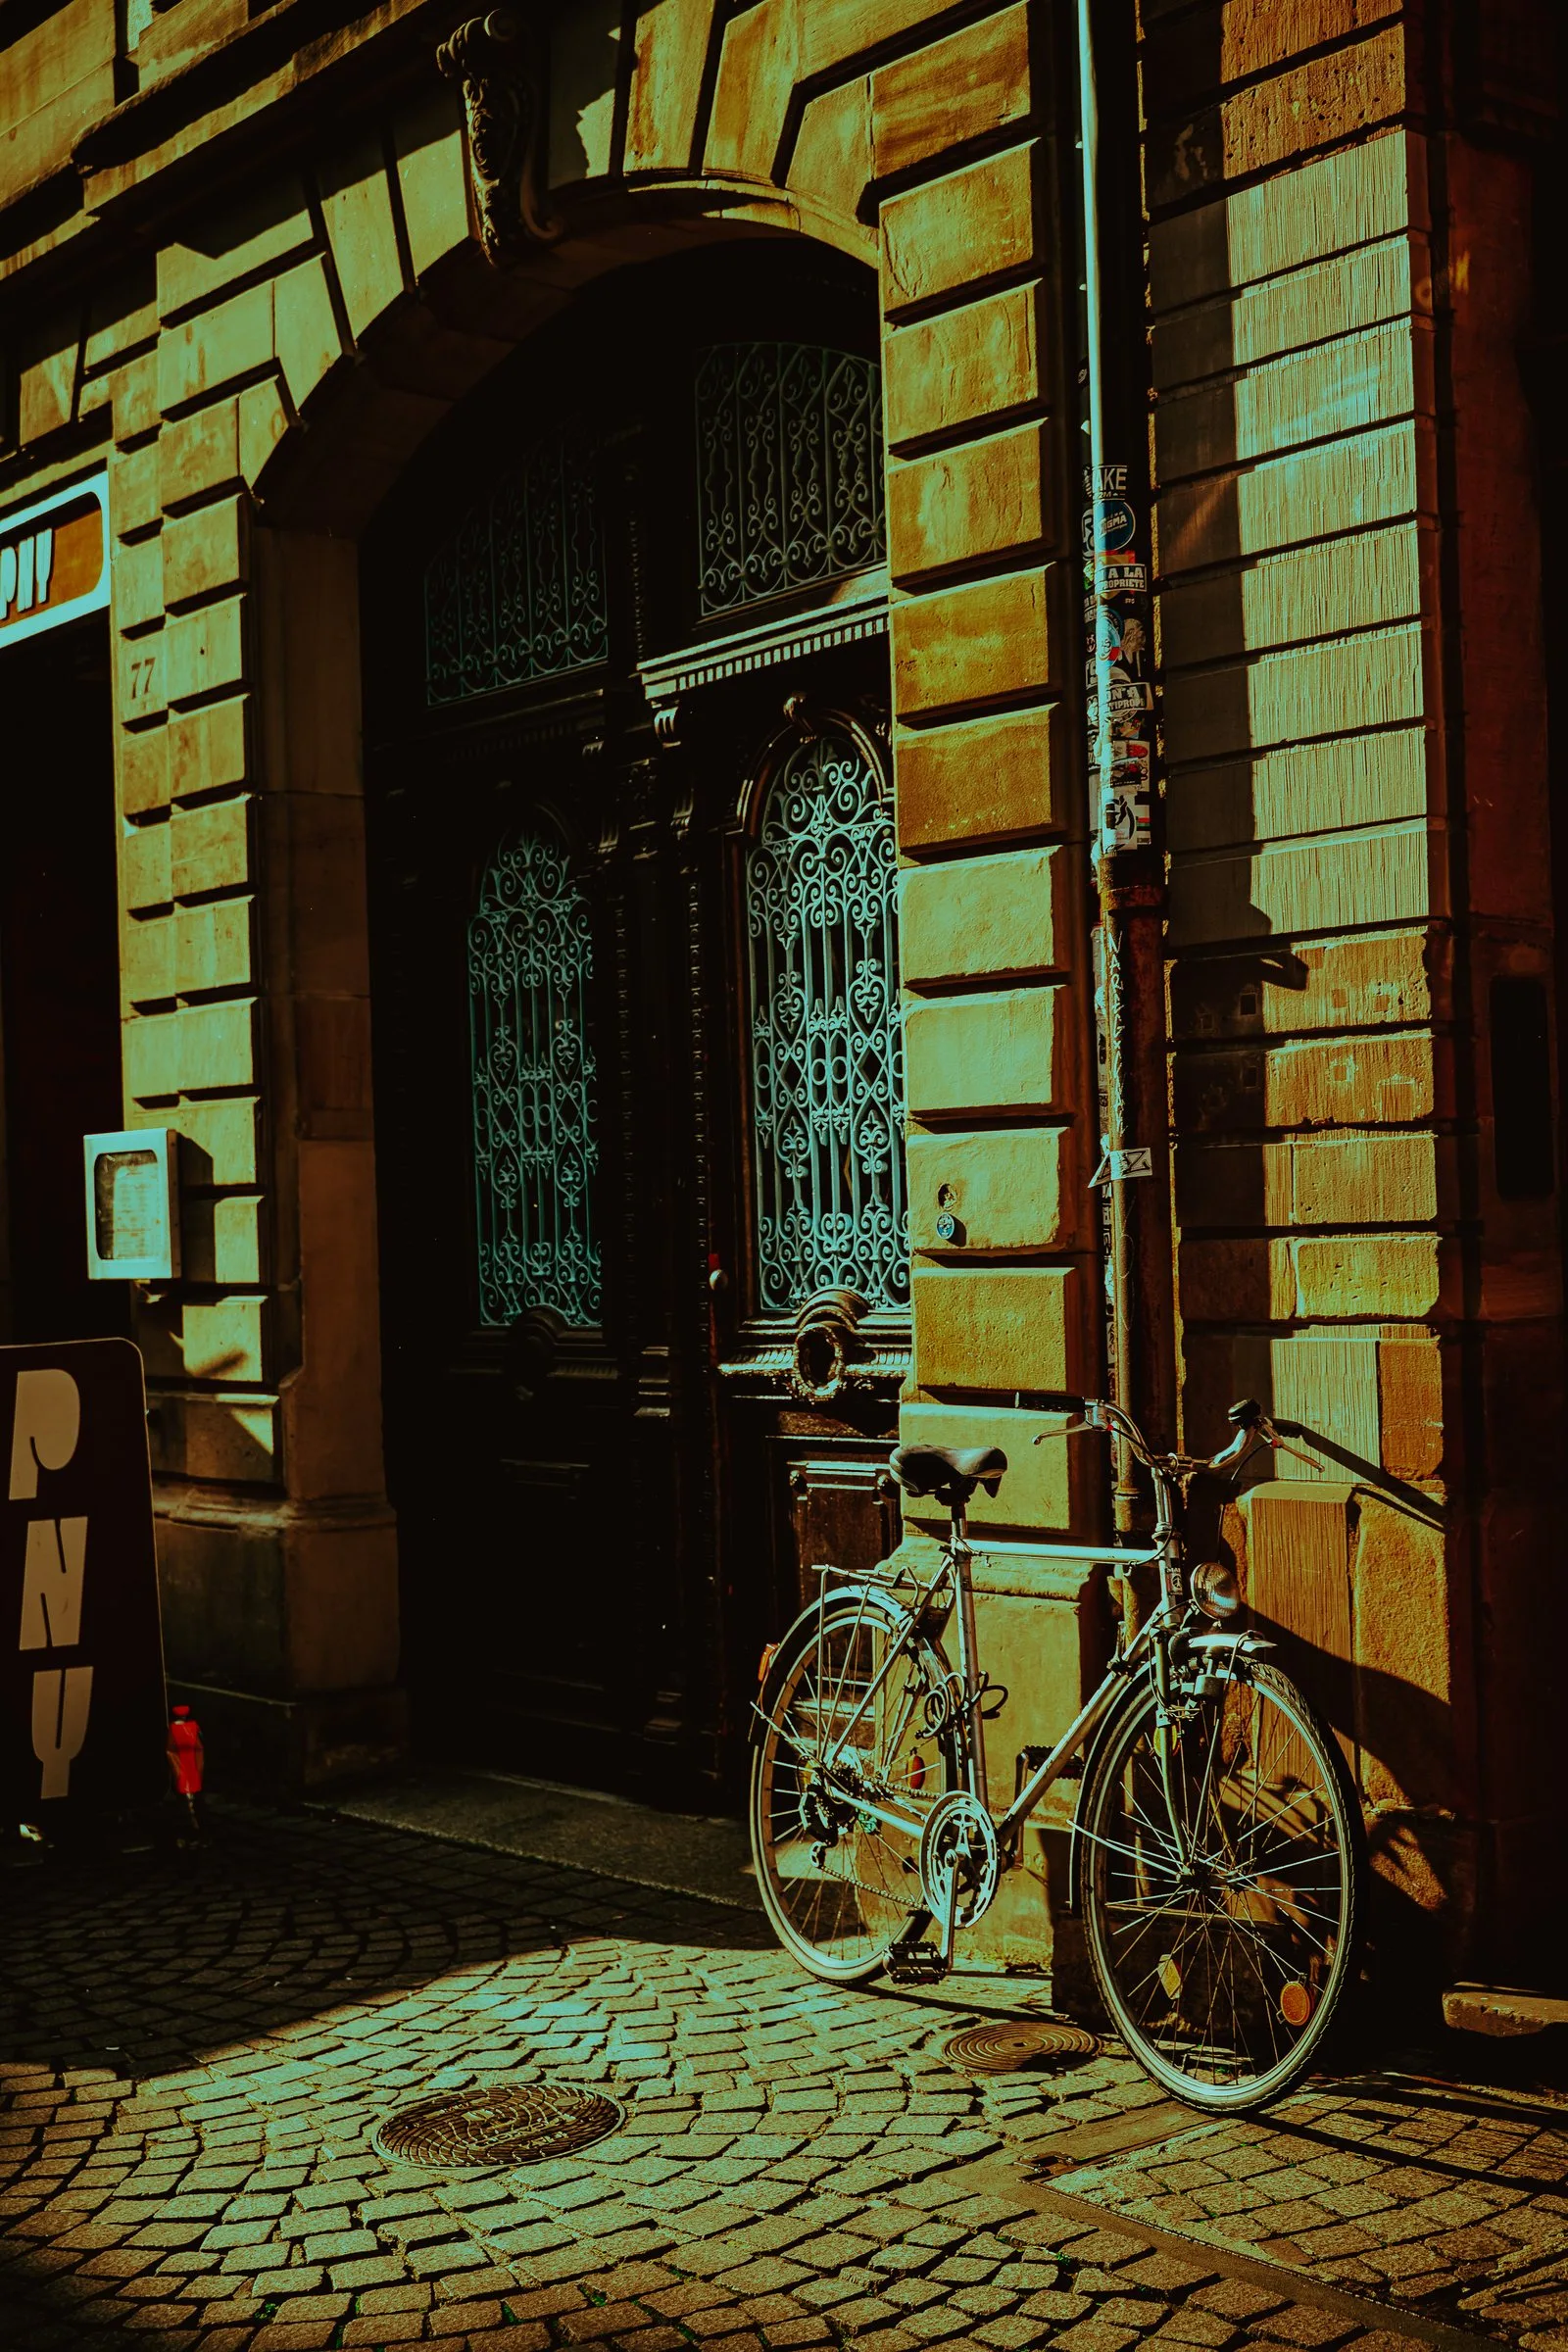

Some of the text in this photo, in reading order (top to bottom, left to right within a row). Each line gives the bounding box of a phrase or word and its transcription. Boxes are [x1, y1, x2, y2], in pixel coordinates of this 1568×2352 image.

[0, 527, 53, 620] PNY
[1108, 567, 1144, 578] A LA
[130, 658, 157, 700] 77
[8, 1367, 94, 1799] PNY
